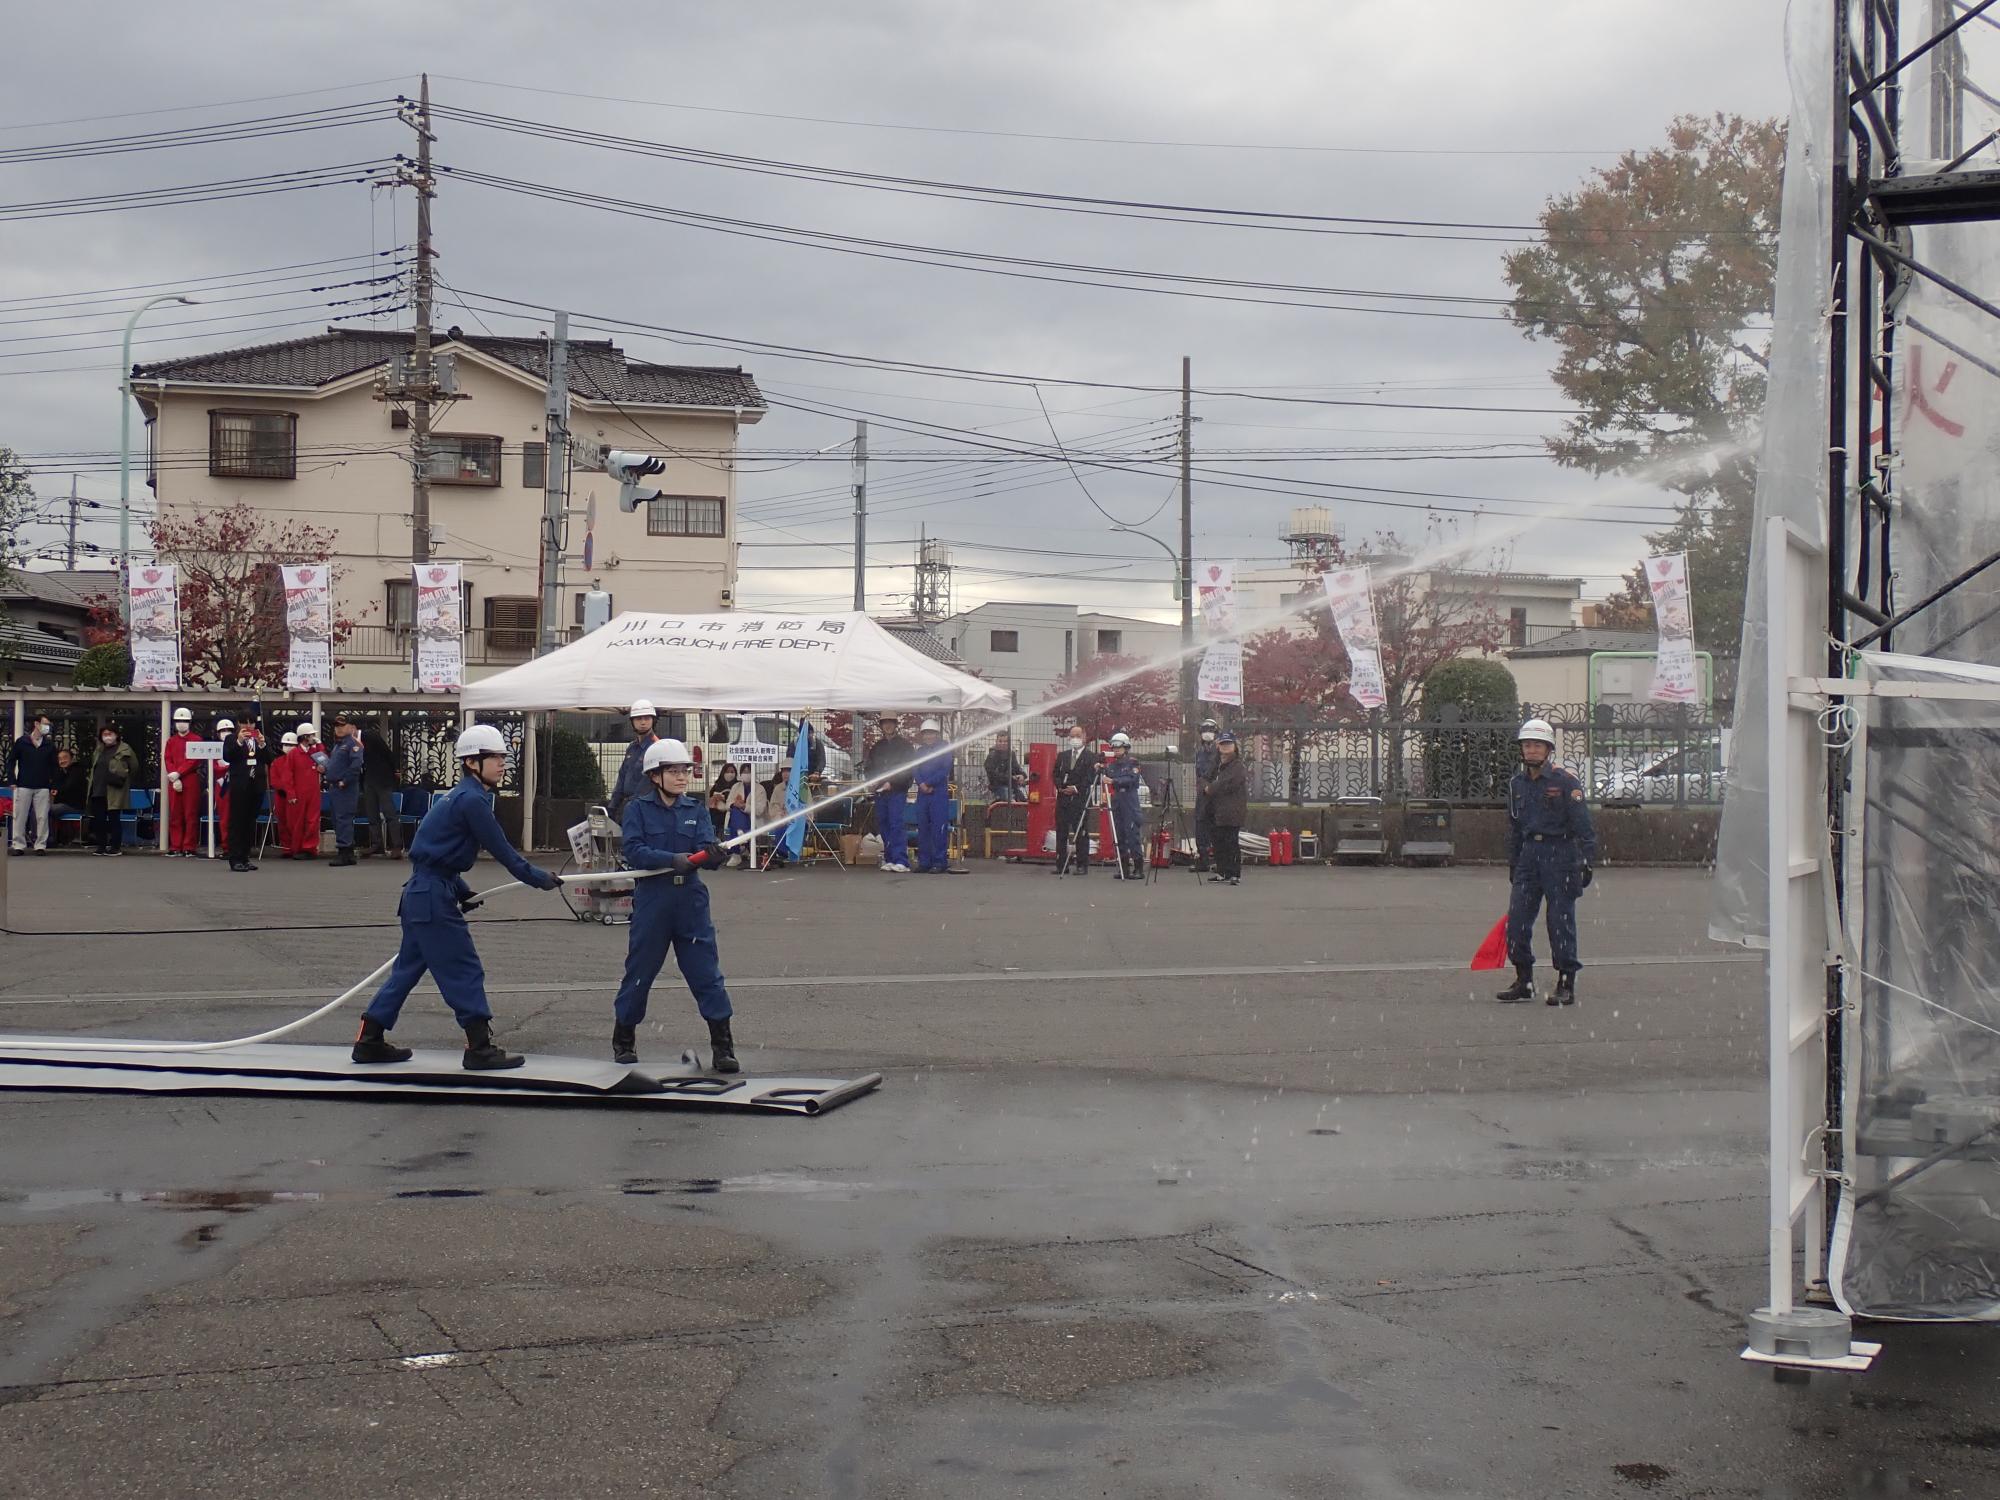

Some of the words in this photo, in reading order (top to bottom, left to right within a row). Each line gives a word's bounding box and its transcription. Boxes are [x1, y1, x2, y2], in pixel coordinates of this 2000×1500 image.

[621, 619, 845, 634] 川口市消防局
[607, 637, 728, 651] KAWAGUCHI
[732, 637, 774, 650] FIRE
[779, 638, 836, 653] DEPT.
